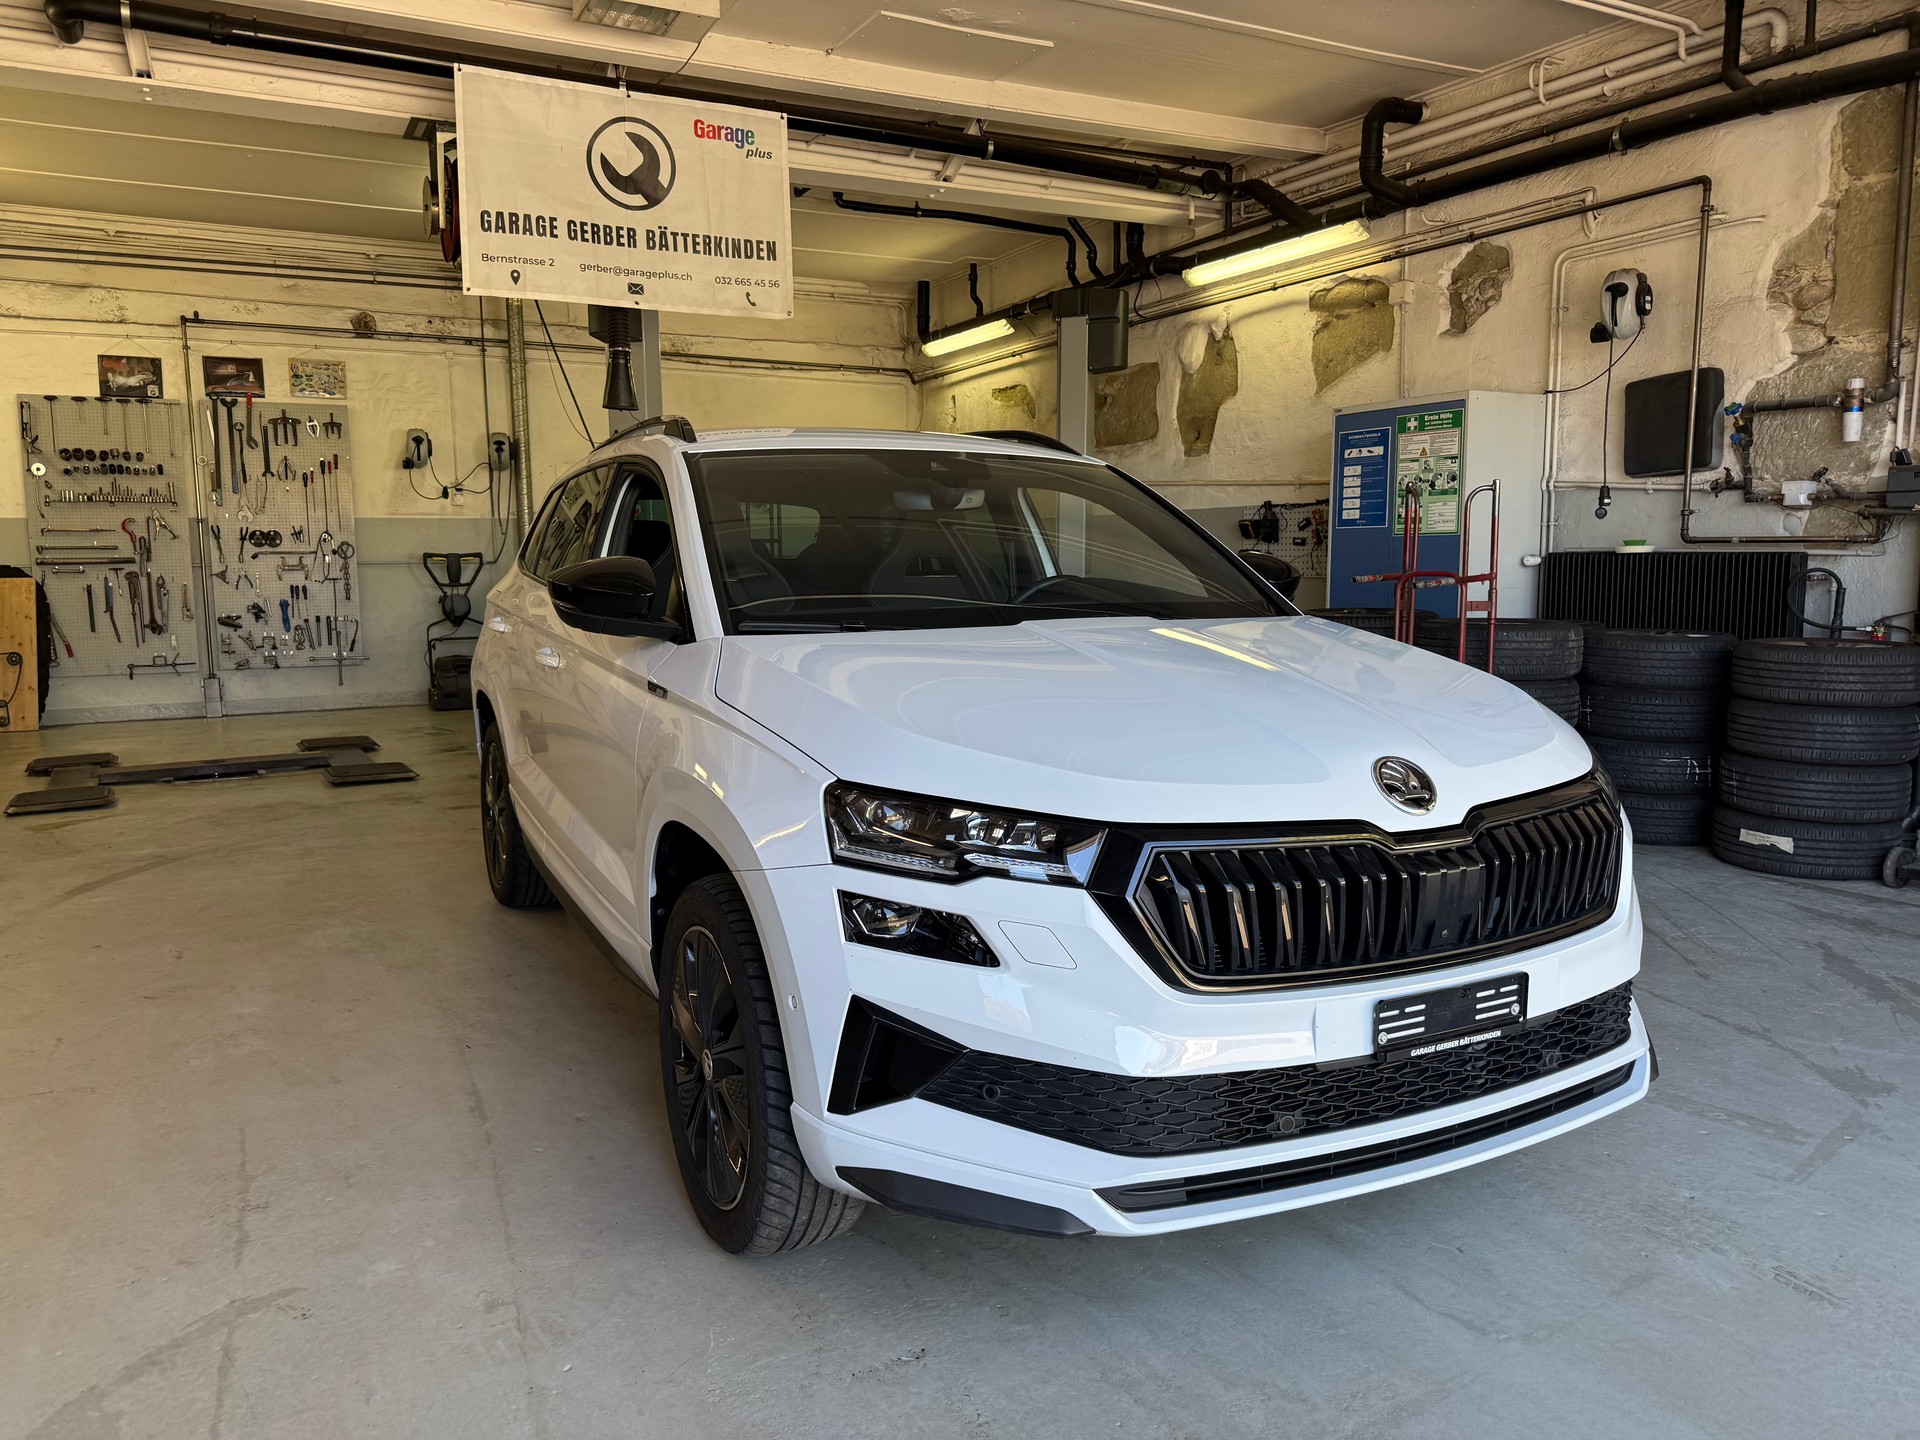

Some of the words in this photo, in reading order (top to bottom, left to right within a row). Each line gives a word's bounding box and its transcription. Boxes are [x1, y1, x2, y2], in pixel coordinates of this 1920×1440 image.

[693, 118, 755, 149] Garage
[745, 147, 773, 160] plus
[480, 209, 559, 239] GARAGE
[566, 219, 637, 249] GERBER
[645, 225, 777, 261] BÄTTERKINDEN
[481, 252, 546, 266] Bernstrasse
[548, 258, 556, 267] 2
[579, 262, 693, 282] gerber@garageplus.ch
[714, 276, 732, 285] 032
[734, 277, 752, 287] 665
[754, 279, 766, 288] 45
[768, 279, 780, 288] 56
[1411, 1045, 1436, 1056] GARAGE
[1436, 1040, 1459, 1051] GERBER
[1460, 1030, 1501, 1045] BÄTTERKINDEN
